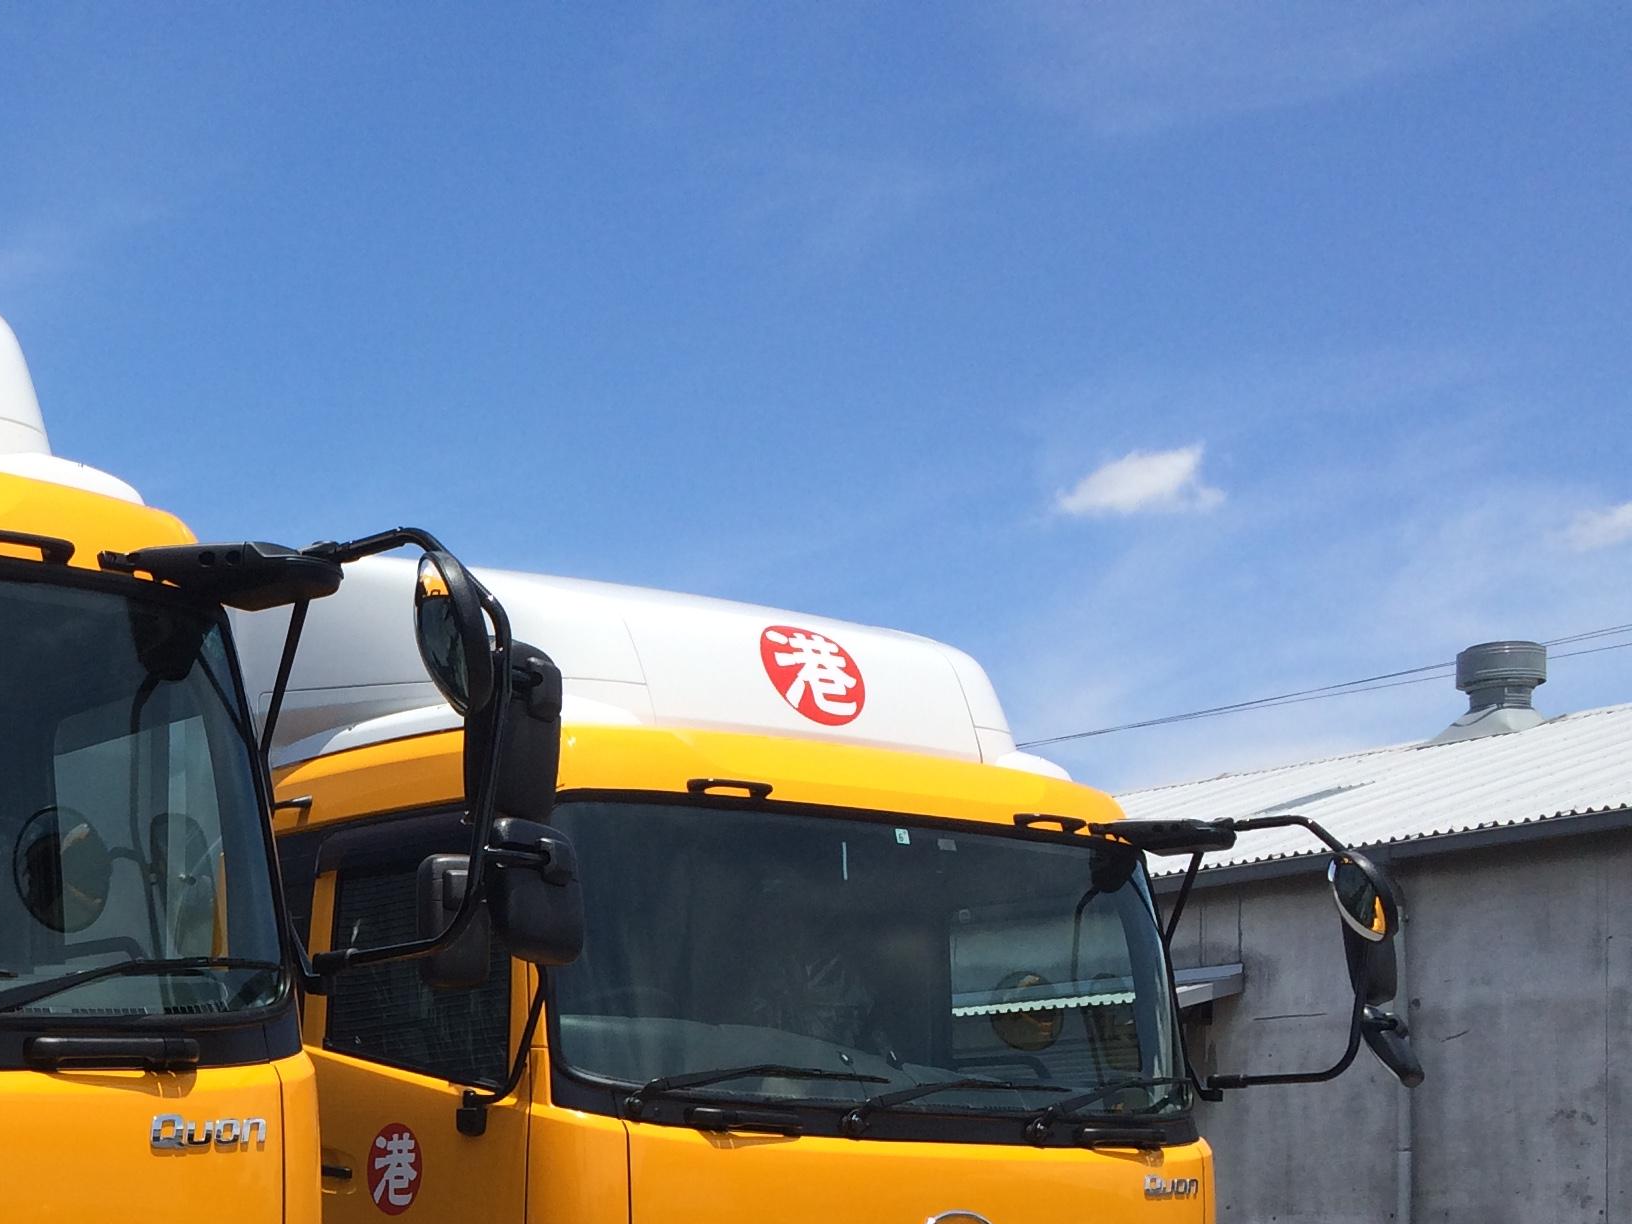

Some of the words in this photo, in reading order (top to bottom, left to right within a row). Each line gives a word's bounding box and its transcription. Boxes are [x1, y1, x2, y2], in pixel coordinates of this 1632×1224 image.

[765, 630, 857, 716] 港
[151, 1113, 266, 1150] Quon
[374, 1132, 418, 1206] 港
